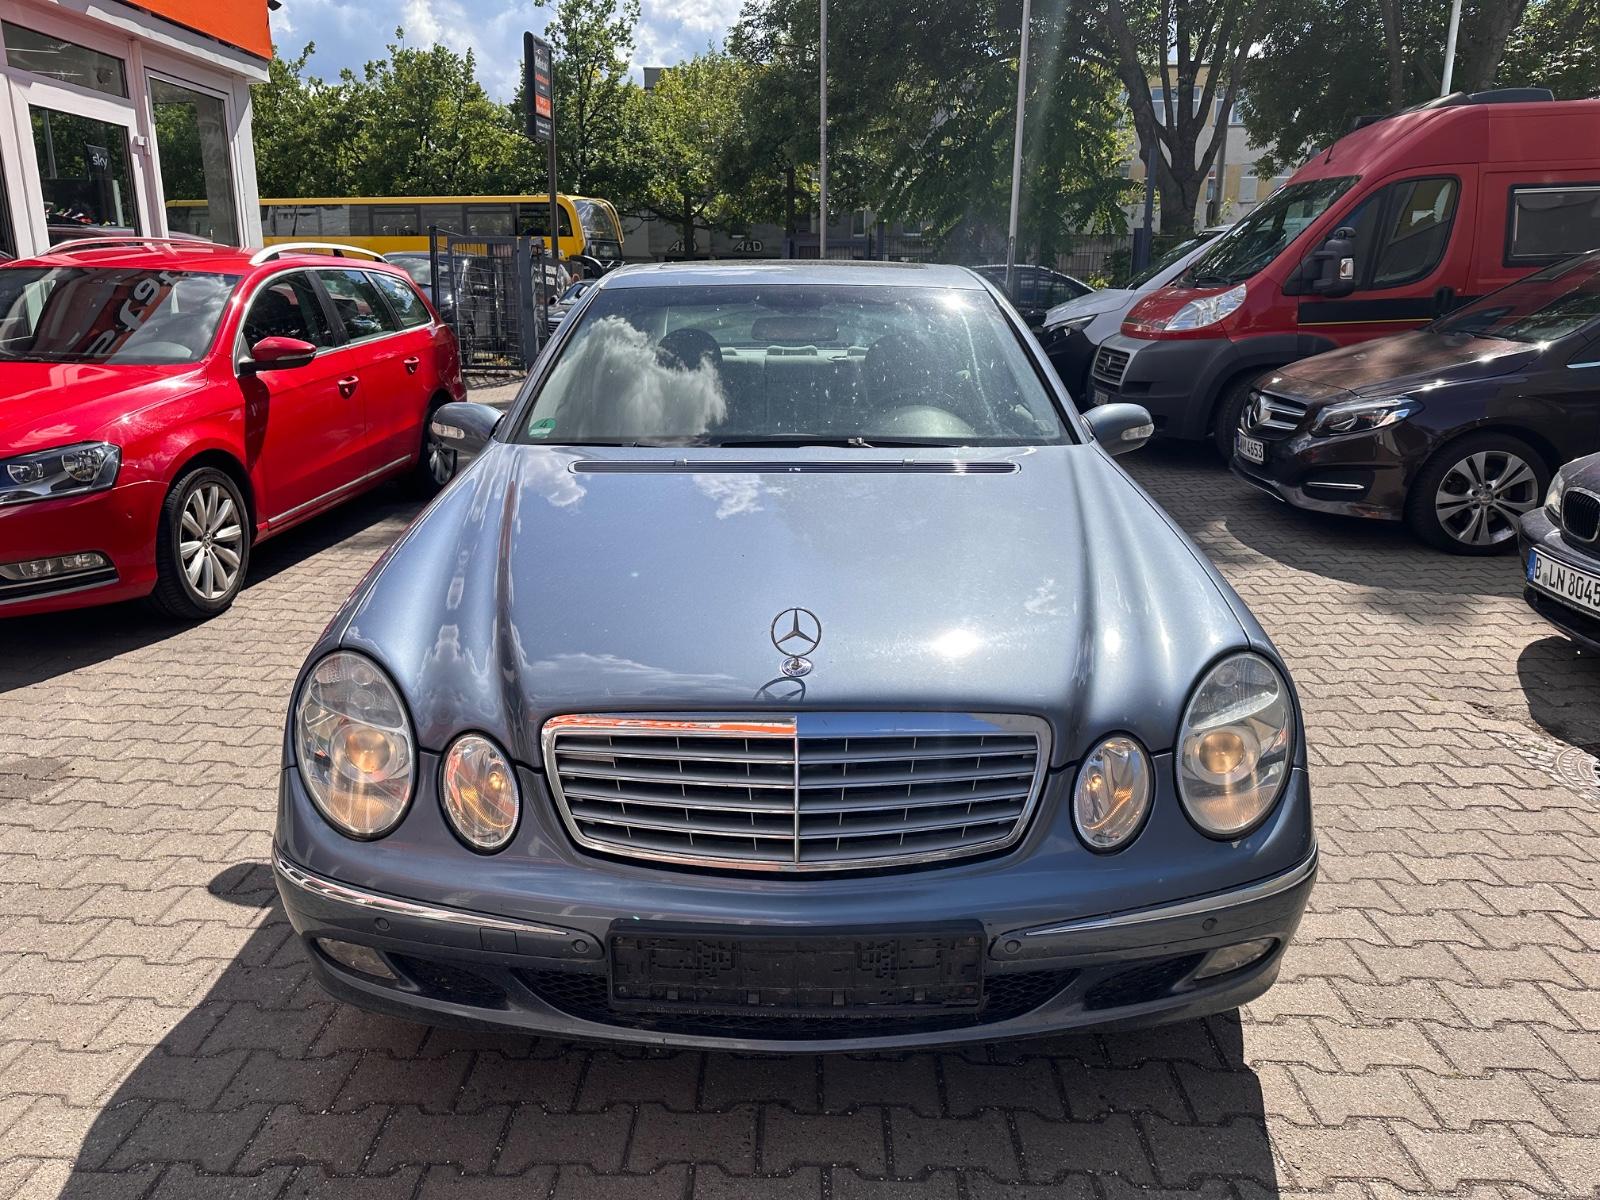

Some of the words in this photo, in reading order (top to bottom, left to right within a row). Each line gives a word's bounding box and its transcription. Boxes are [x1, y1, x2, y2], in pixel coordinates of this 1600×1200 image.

[92, 152, 108, 170] sky
[734, 240, 763, 252] A&D
[1535, 557, 1542, 580] B
[1549, 563, 1566, 593] LN
[1568, 572, 1600, 607] 8045
